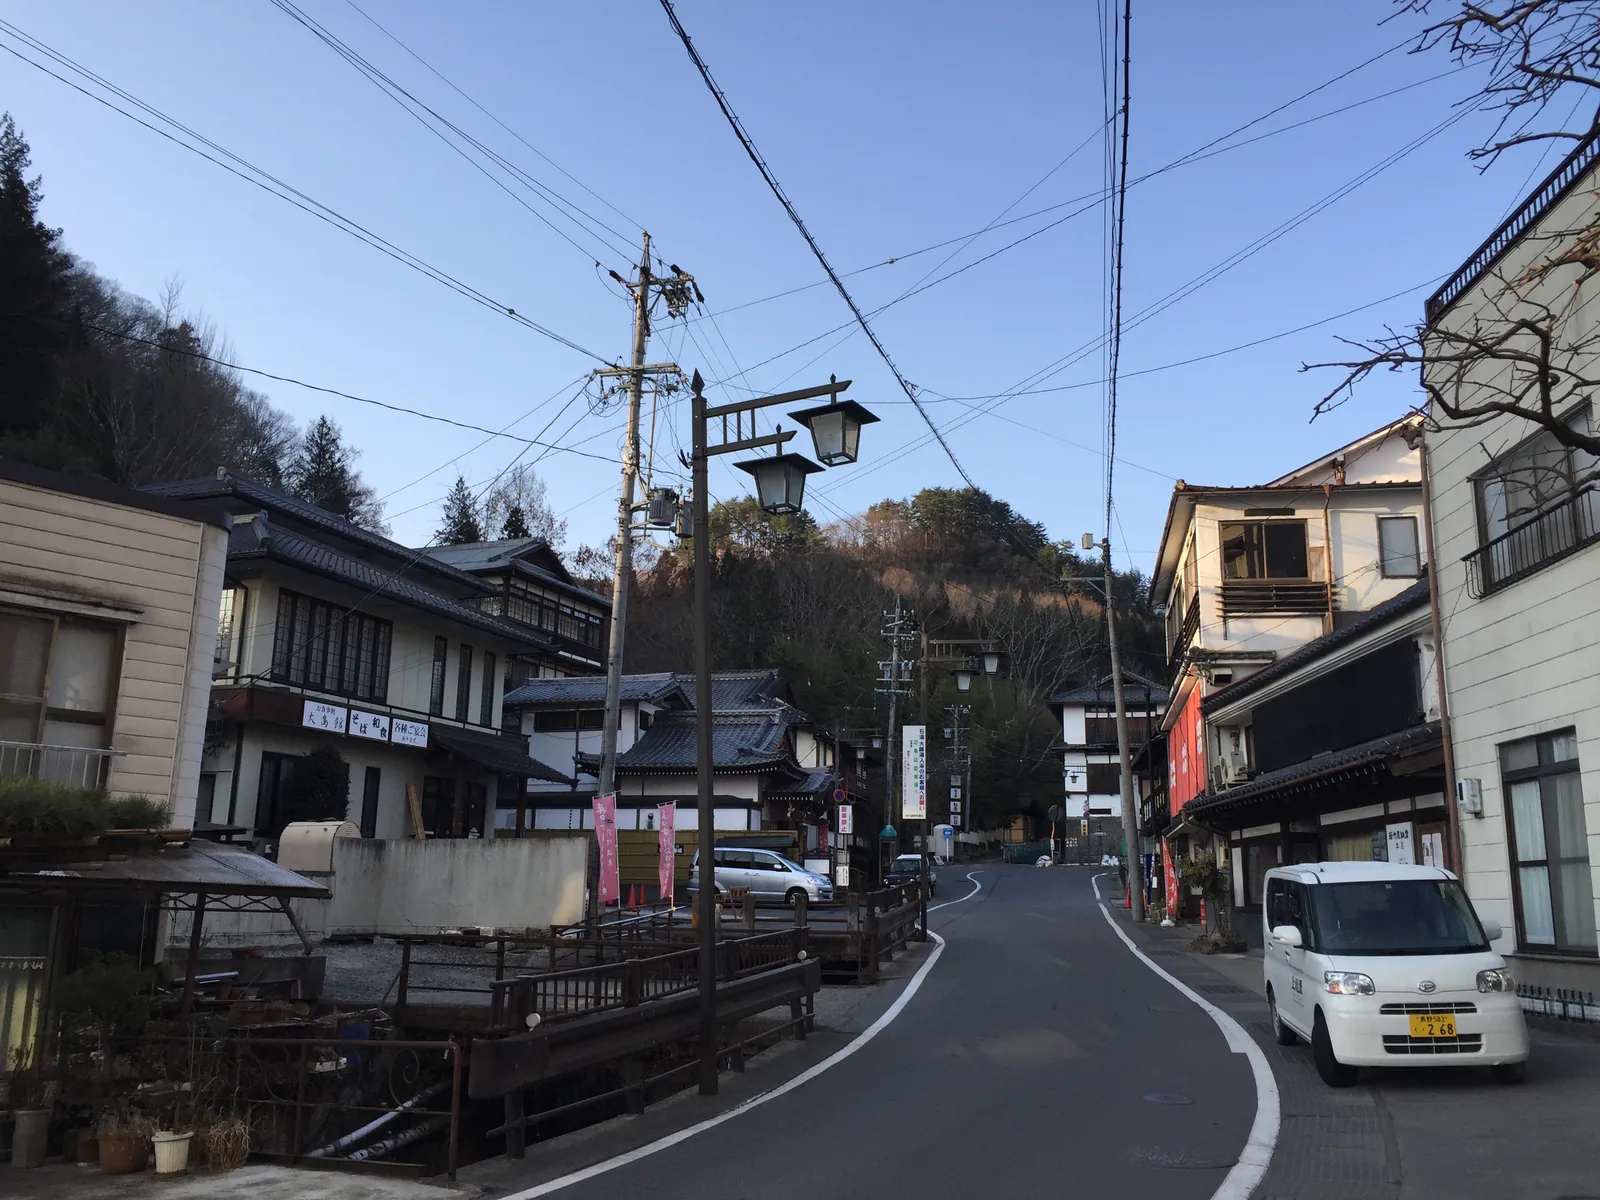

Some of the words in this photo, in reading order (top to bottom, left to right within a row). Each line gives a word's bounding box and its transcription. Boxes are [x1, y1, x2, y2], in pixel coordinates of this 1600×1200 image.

[307, 711, 344, 730] 大島館
[372, 716, 387, 738] 和食
